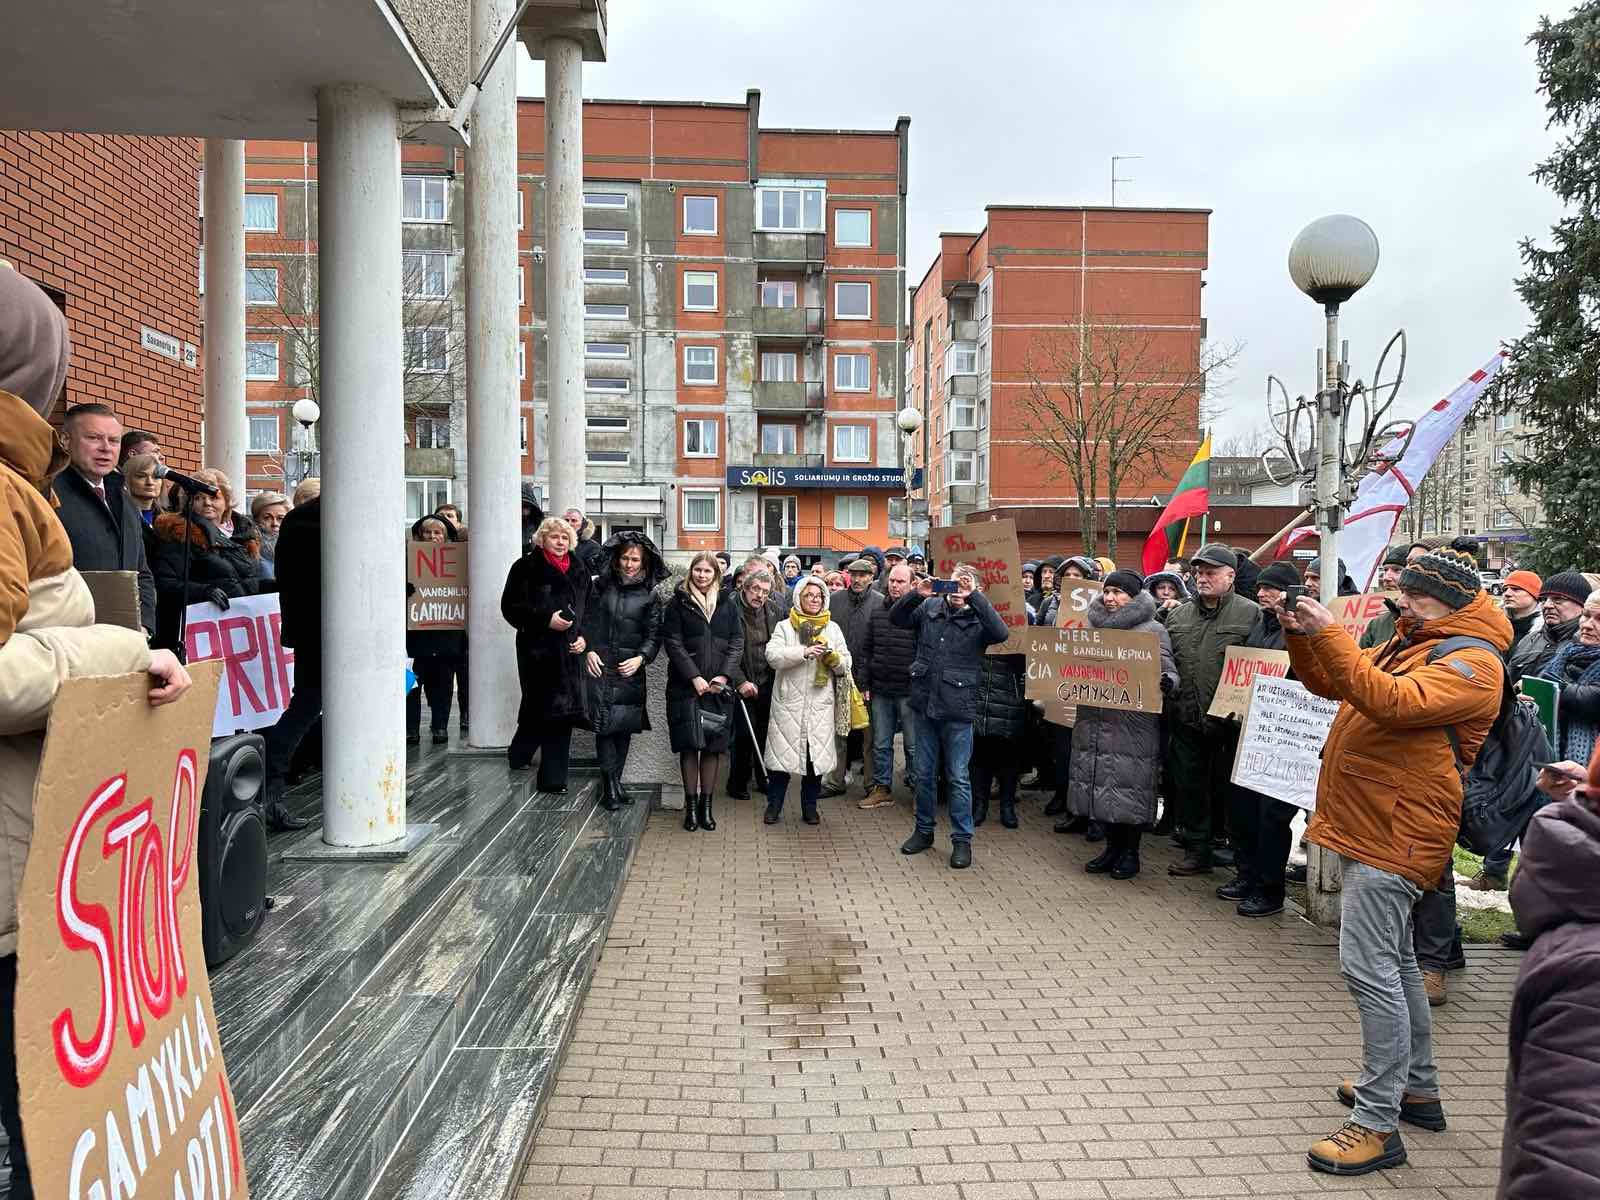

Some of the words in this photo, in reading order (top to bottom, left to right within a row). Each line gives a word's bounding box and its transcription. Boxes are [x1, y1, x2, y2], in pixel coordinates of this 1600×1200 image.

[794, 474, 841, 483] SOLIARIUMŲ
[852, 474, 880, 482] GROŽIO
[416, 545, 457, 578] NE
[1343, 594, 1386, 619] NE
[1031, 640, 1048, 652] ČIA
[1055, 642, 1068, 654] NE
[1027, 658, 1052, 680] ČIA
[1059, 664, 1129, 686] VANDENILIO
[52, 748, 198, 1088] STOP
